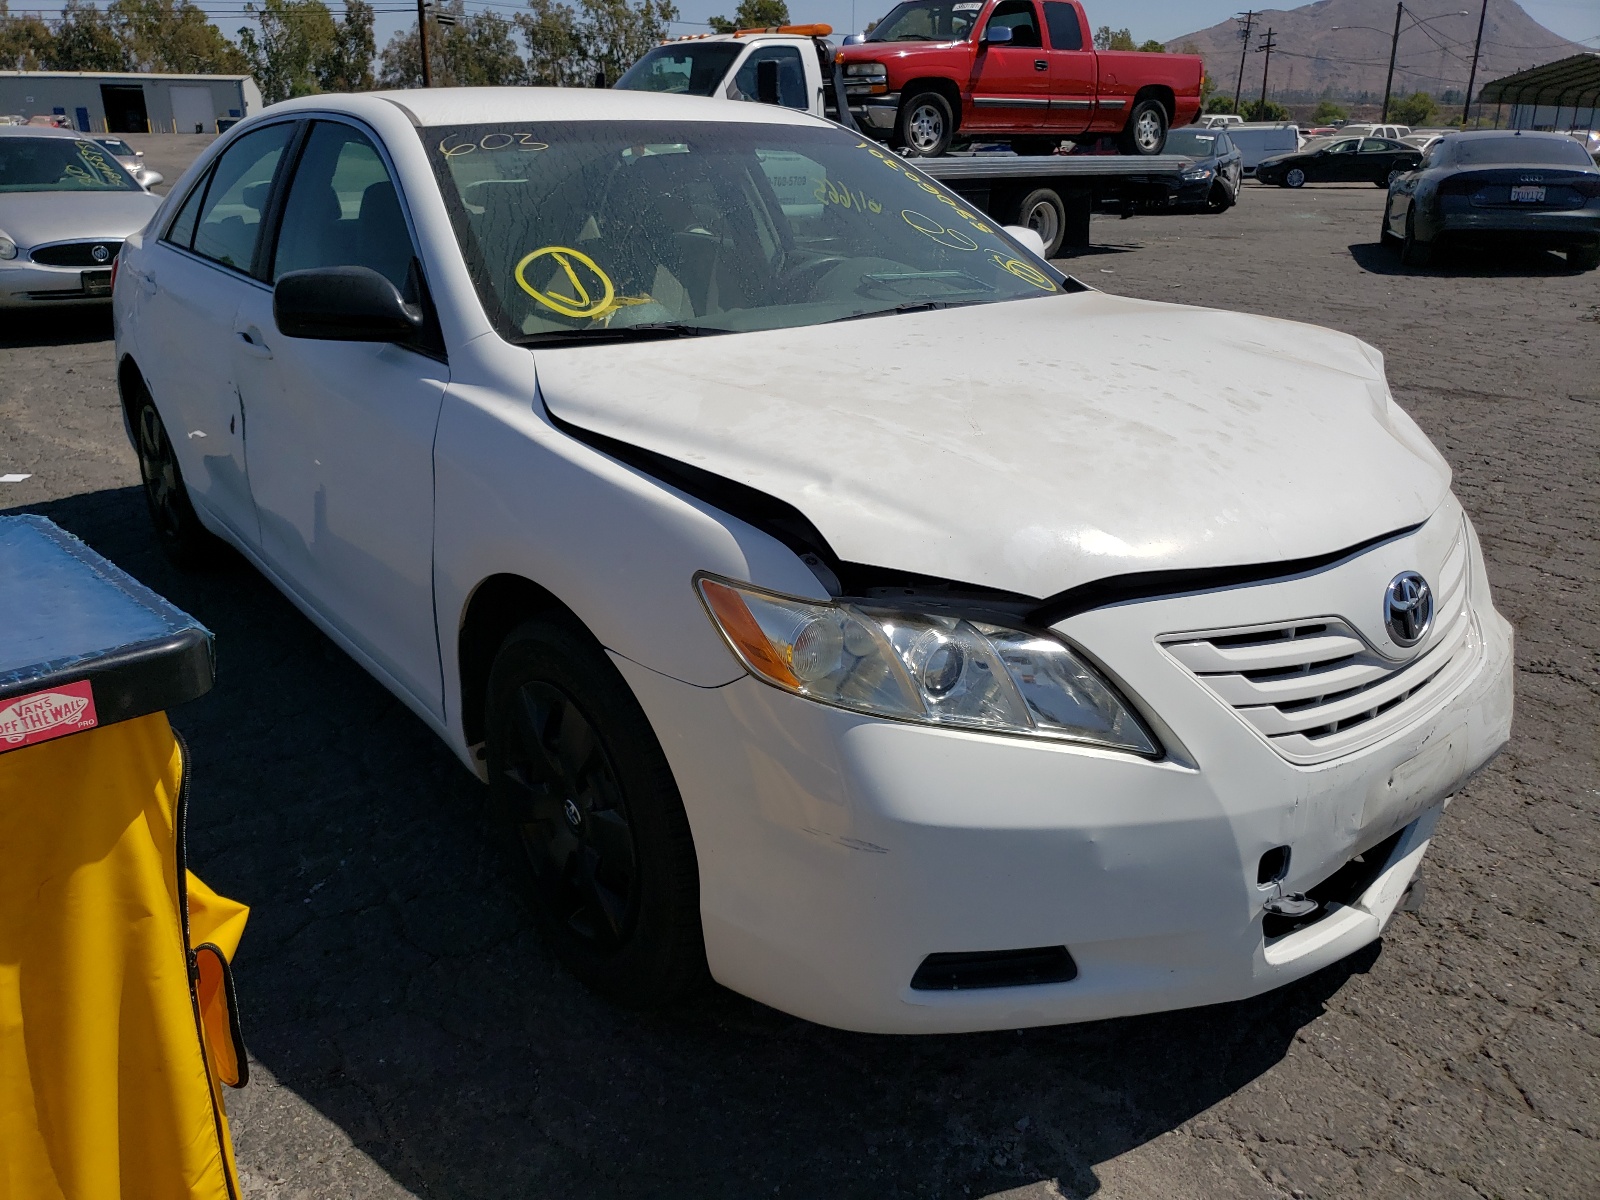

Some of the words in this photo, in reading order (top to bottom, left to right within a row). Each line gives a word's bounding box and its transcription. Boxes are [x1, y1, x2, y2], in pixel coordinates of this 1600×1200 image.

[440, 133, 549, 158] 603
[11, 698, 53, 717] VANS
[20, 710, 51, 730] THE
[49, 699, 82, 721] WALL
[78, 718, 95, 728] PRO
